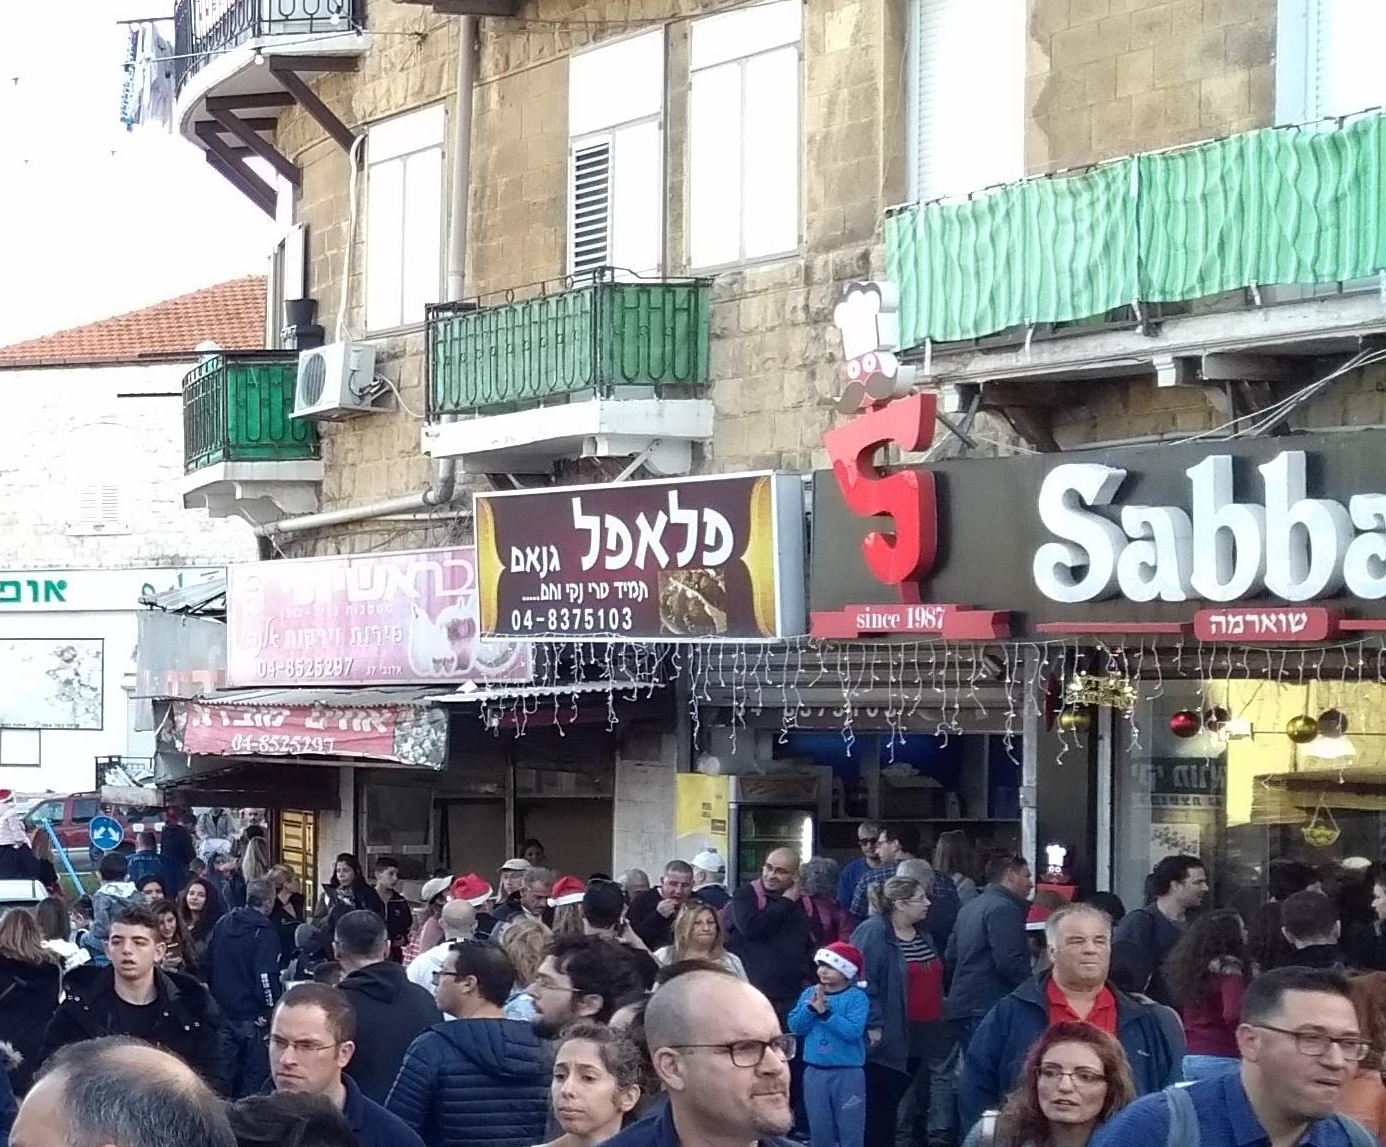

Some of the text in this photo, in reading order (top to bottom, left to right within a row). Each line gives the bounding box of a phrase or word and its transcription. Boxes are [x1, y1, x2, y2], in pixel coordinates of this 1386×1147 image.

[571, 490, 734, 572] פלאפל
[1033, 450, 1386, 603] Sabba
[510, 544, 561, 579] גנאם
[565, 582, 584, 604] נקי
[588, 582, 609, 600] טרי
[613, 580, 649, 602] תמיד
[511, 607, 632, 631] 04-8375103
[856, 605, 946, 630] since 1987
[1209, 611, 1309, 636] שוארמה
[349, 625, 404, 650] פירות
[257, 657, 355, 679] 04-8525297
[232, 733, 335, 752] 04-8525297
